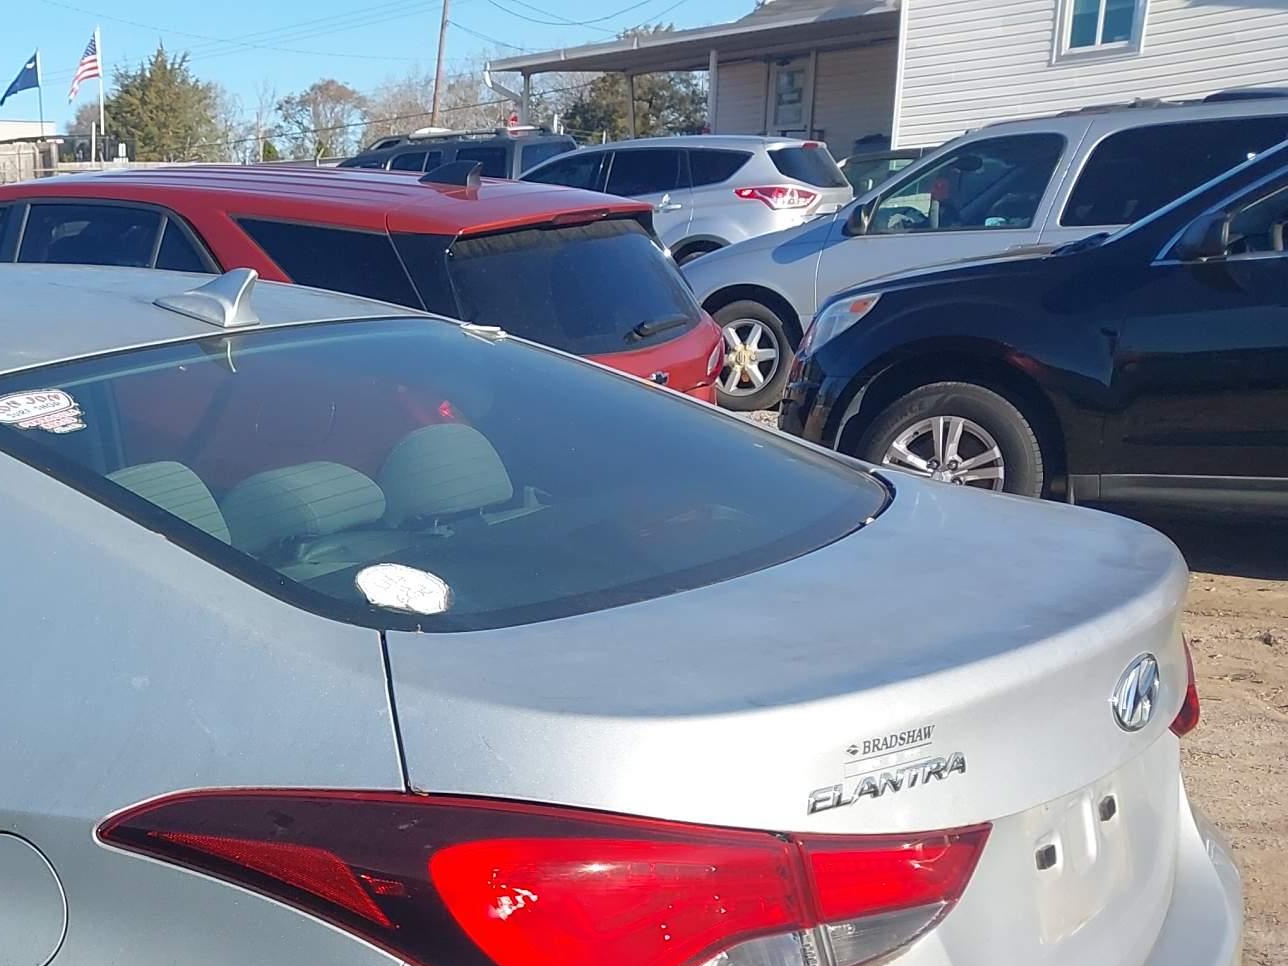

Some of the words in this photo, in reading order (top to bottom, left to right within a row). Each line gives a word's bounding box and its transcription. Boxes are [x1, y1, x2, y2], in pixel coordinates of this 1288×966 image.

[25, 393, 61, 405] JON
[33, 401, 61, 411] SHOP
[862, 724, 936, 755] BRADSHAW
[807, 751, 967, 816] ELANTRA
